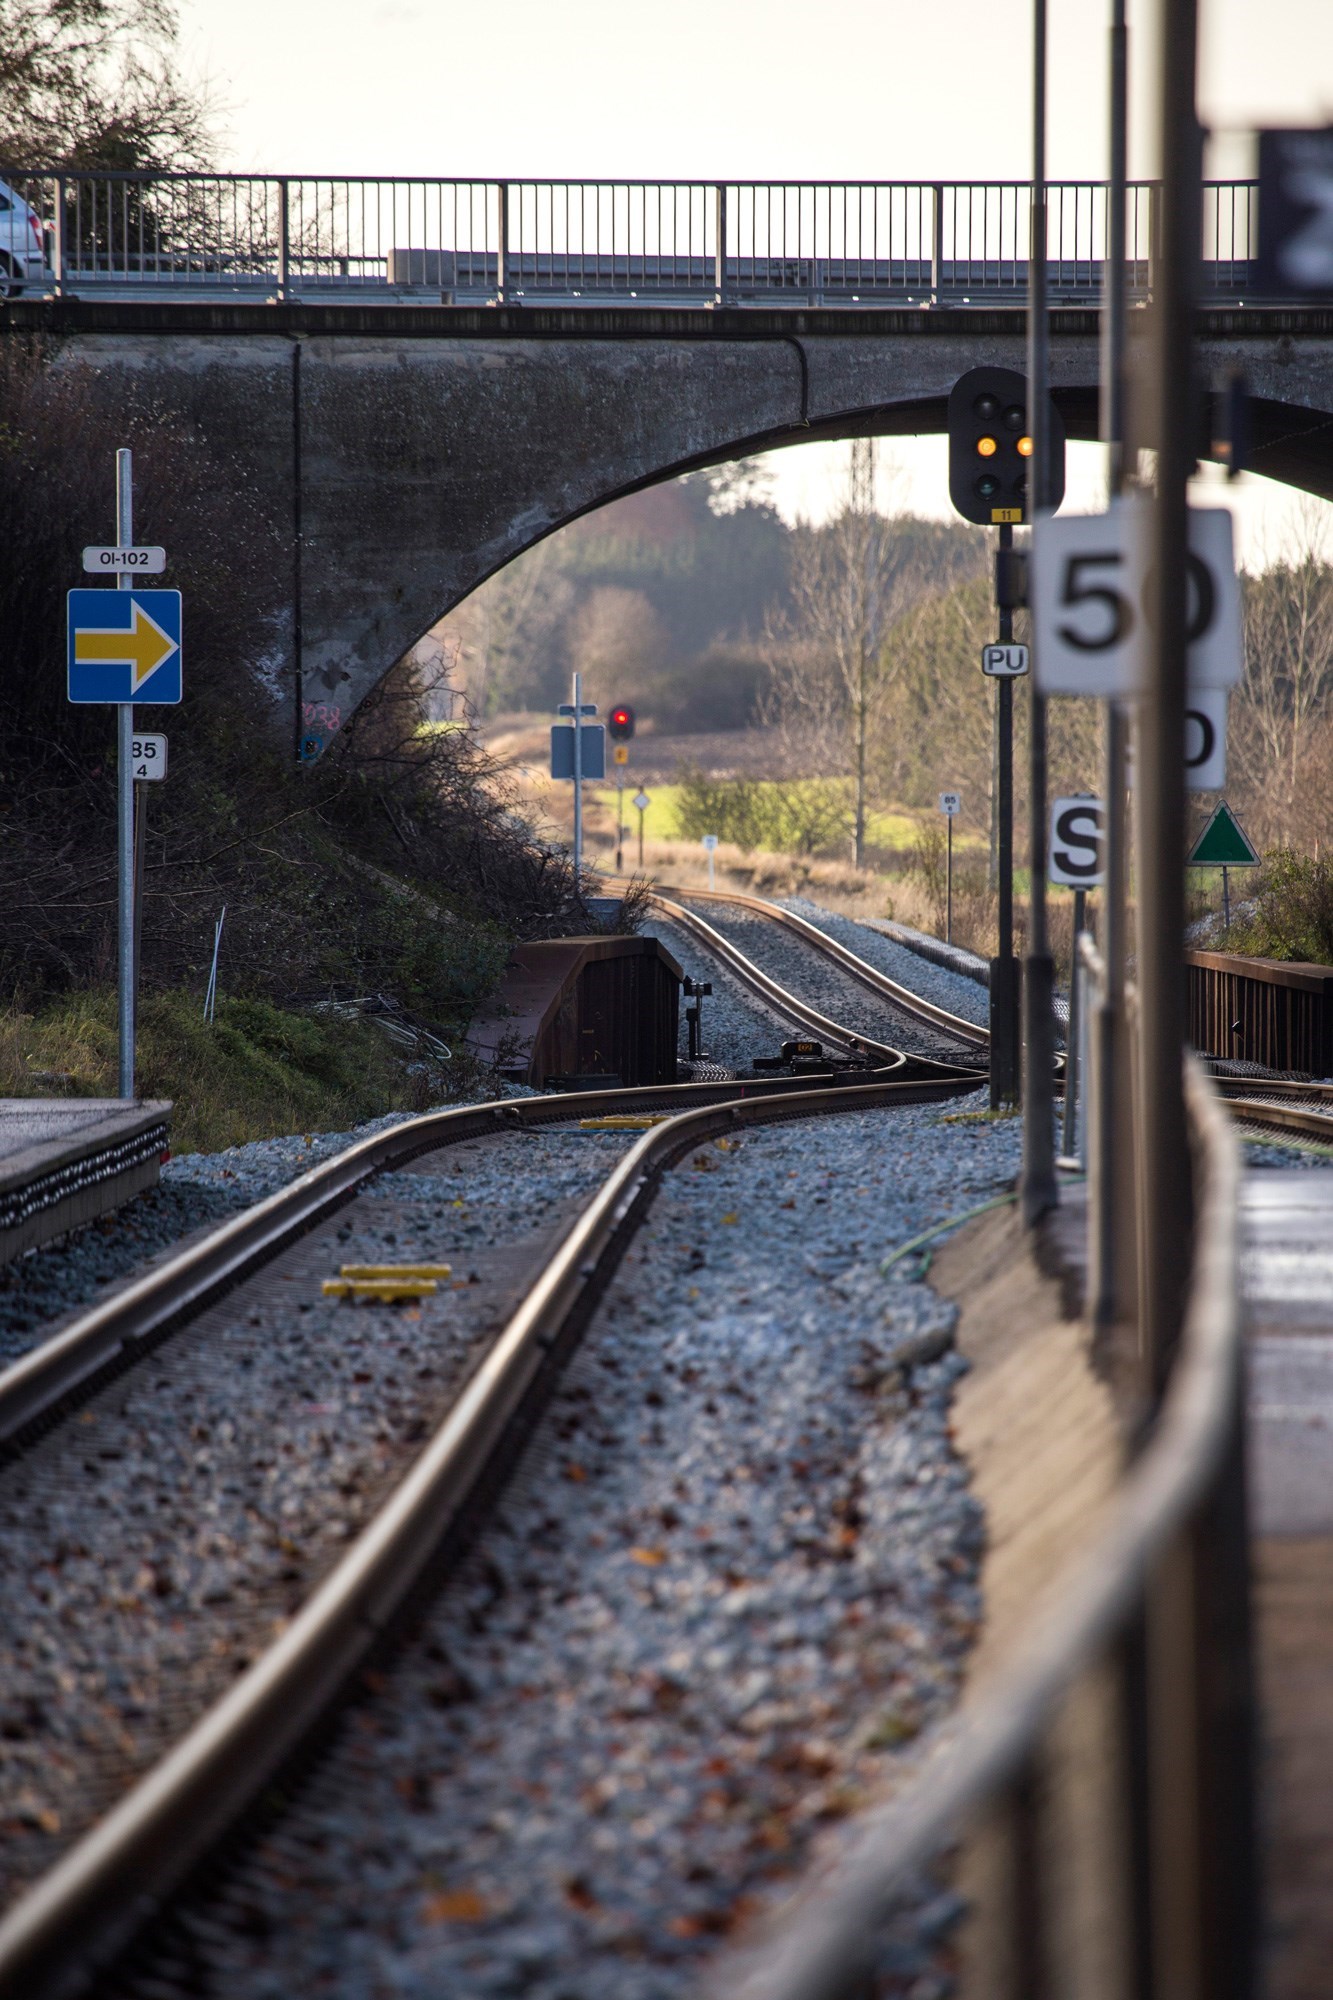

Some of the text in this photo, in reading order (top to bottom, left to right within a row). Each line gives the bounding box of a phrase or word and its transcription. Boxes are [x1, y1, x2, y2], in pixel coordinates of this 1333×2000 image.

[1001, 510, 1011, 521] 11
[988, 649, 1024, 671] PU
[132, 741, 156, 759] 85
[136, 764, 147, 777] 4
[1053, 806, 1107, 878] S
